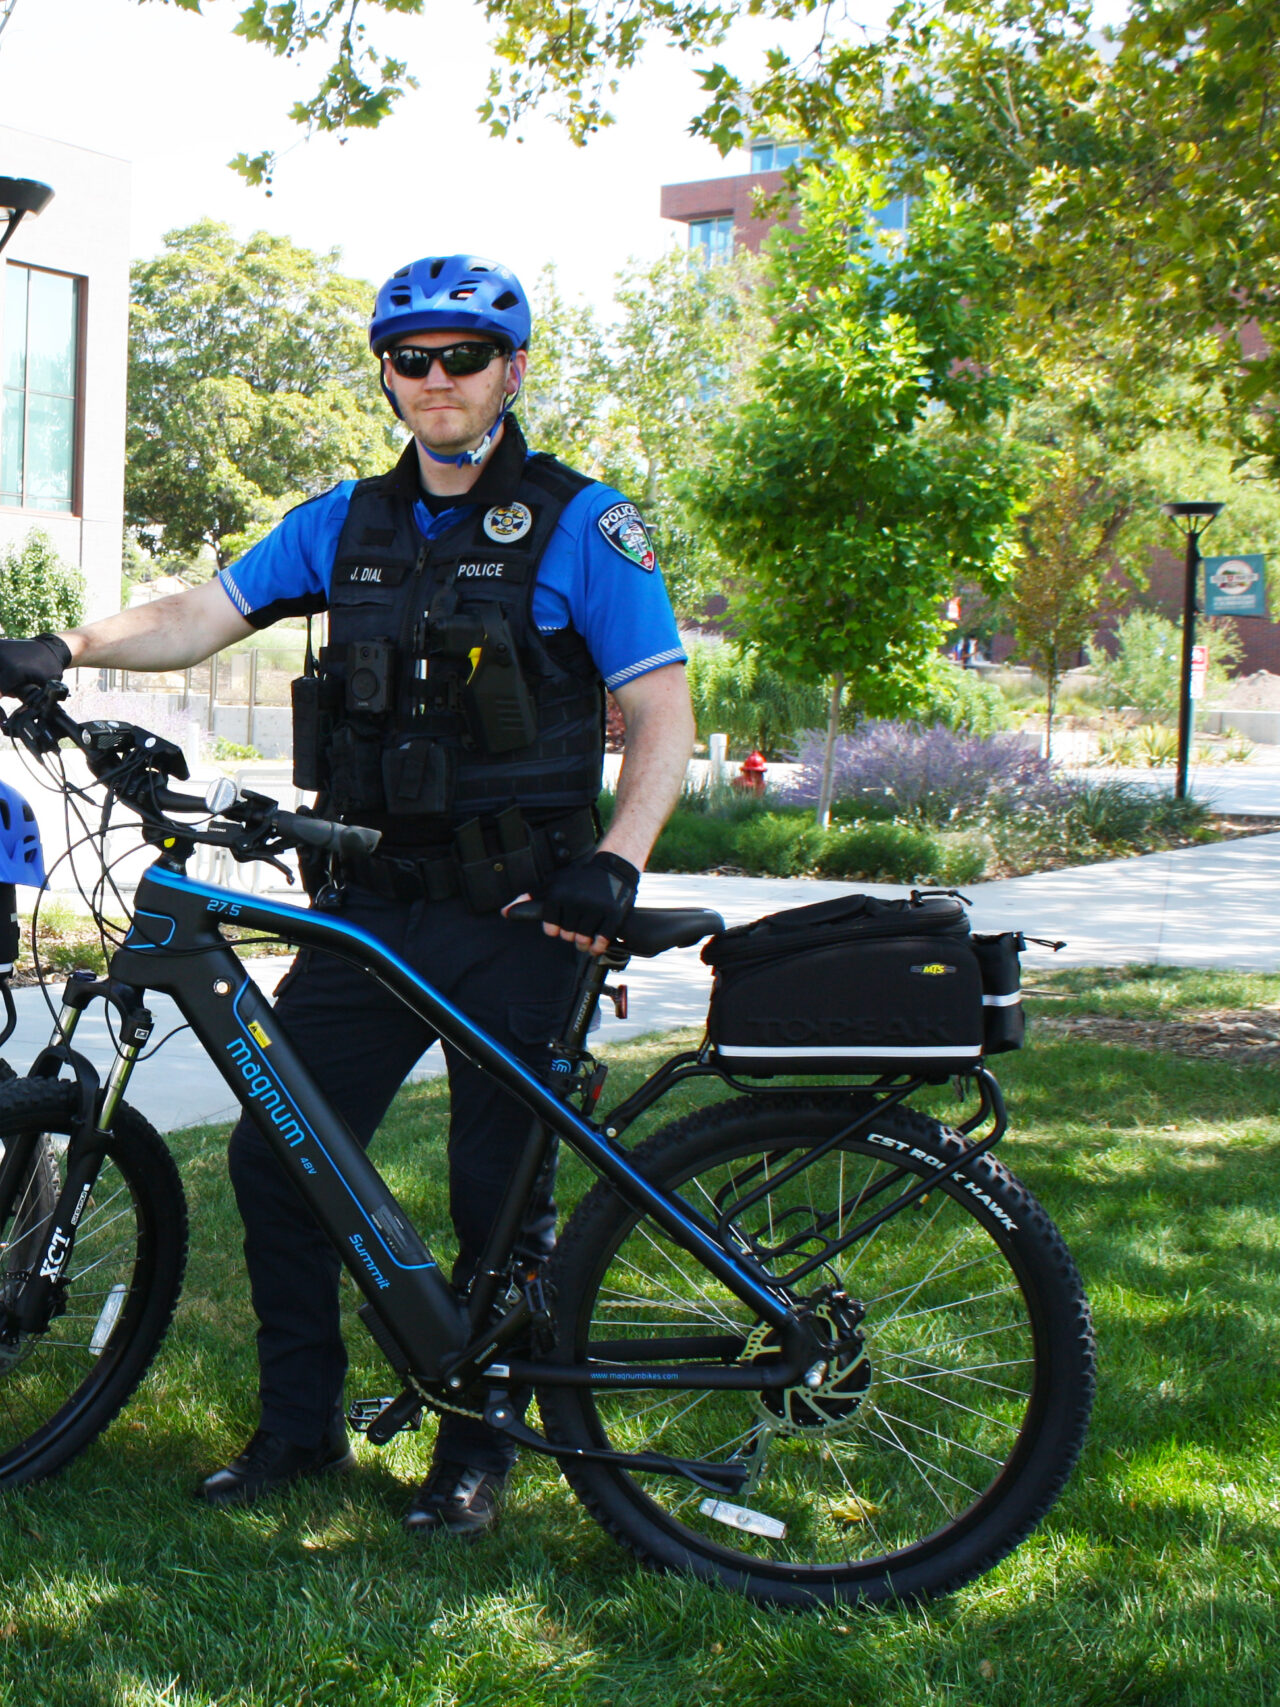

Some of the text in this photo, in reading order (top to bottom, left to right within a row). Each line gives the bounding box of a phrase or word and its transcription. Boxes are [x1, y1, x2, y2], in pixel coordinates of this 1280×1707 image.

[601, 505, 637, 529] POLICE
[350, 567, 382, 583] J. DIAL
[457, 563, 505, 577] POLICE
[206, 899, 243, 917] 27.5
[922, 963, 946, 975] MTS
[745, 1016, 952, 1043] TOPEAK
[226, 1037, 305, 1147] magnum
[300, 1157, 318, 1175] 48V
[866, 1133, 910, 1151] CST
[964, 1181, 1019, 1232] HAWK
[39, 1226, 71, 1284] XCT
[349, 1234, 391, 1290] Summit
